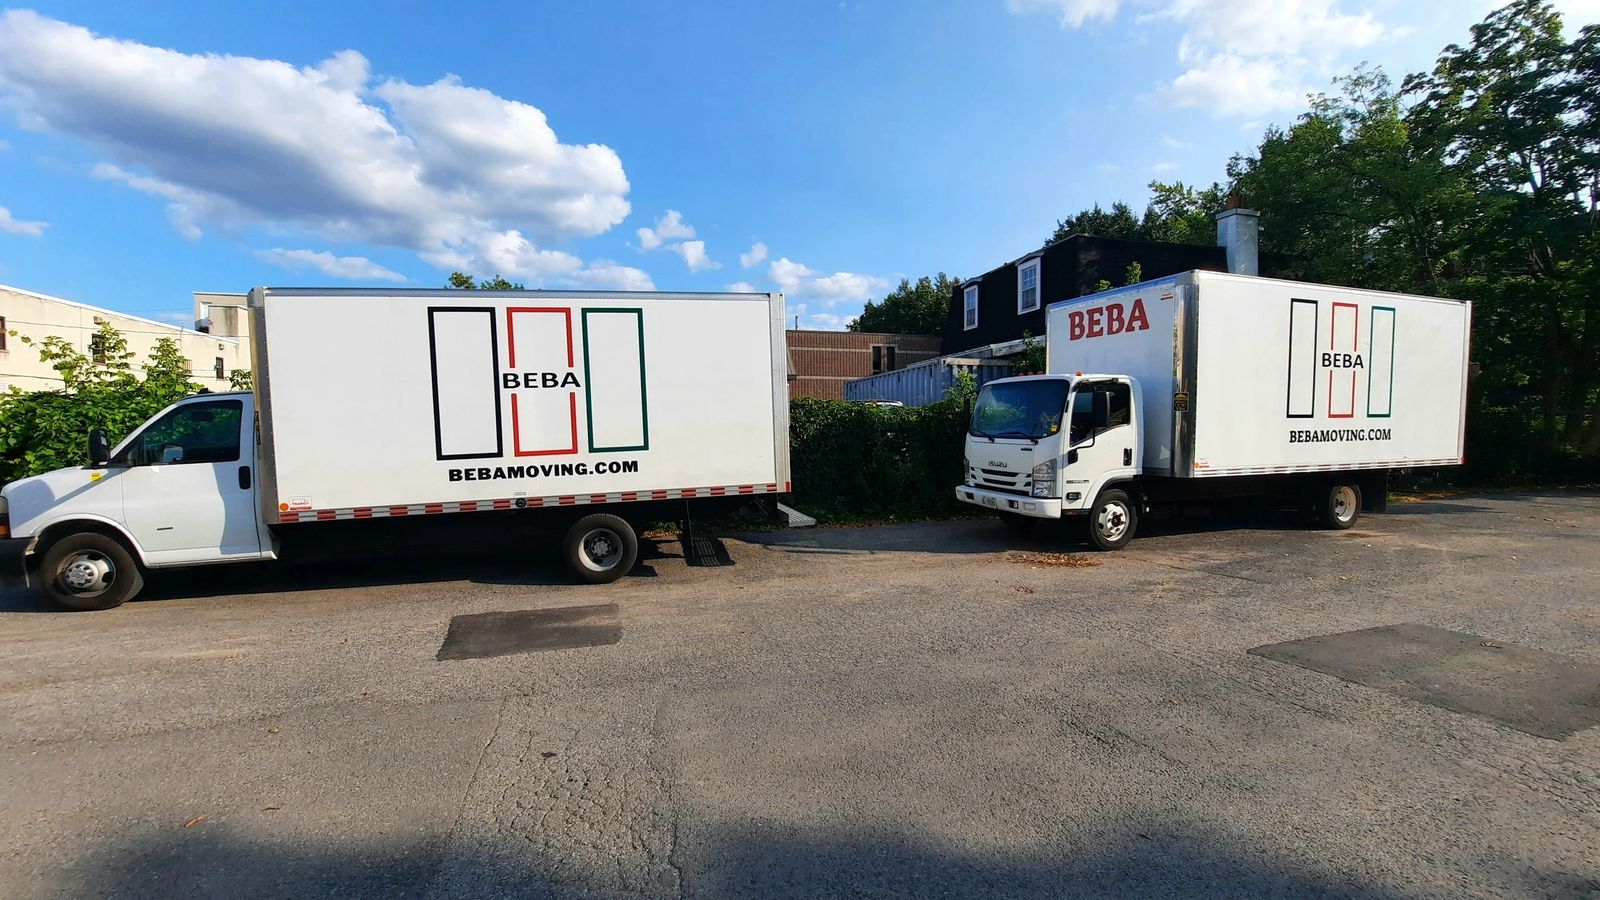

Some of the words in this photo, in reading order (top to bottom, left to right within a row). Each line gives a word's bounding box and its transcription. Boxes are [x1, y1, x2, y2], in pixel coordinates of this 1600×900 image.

[1068, 298, 1150, 341] BEBA
[1321, 352, 1364, 369] BEBA
[502, 372, 581, 389] BEBA
[1289, 428, 1392, 443] BEBAMOVING.COM
[448, 460, 639, 482] BEBAMOVING.COM
[988, 460, 1008, 468] ISUZU
